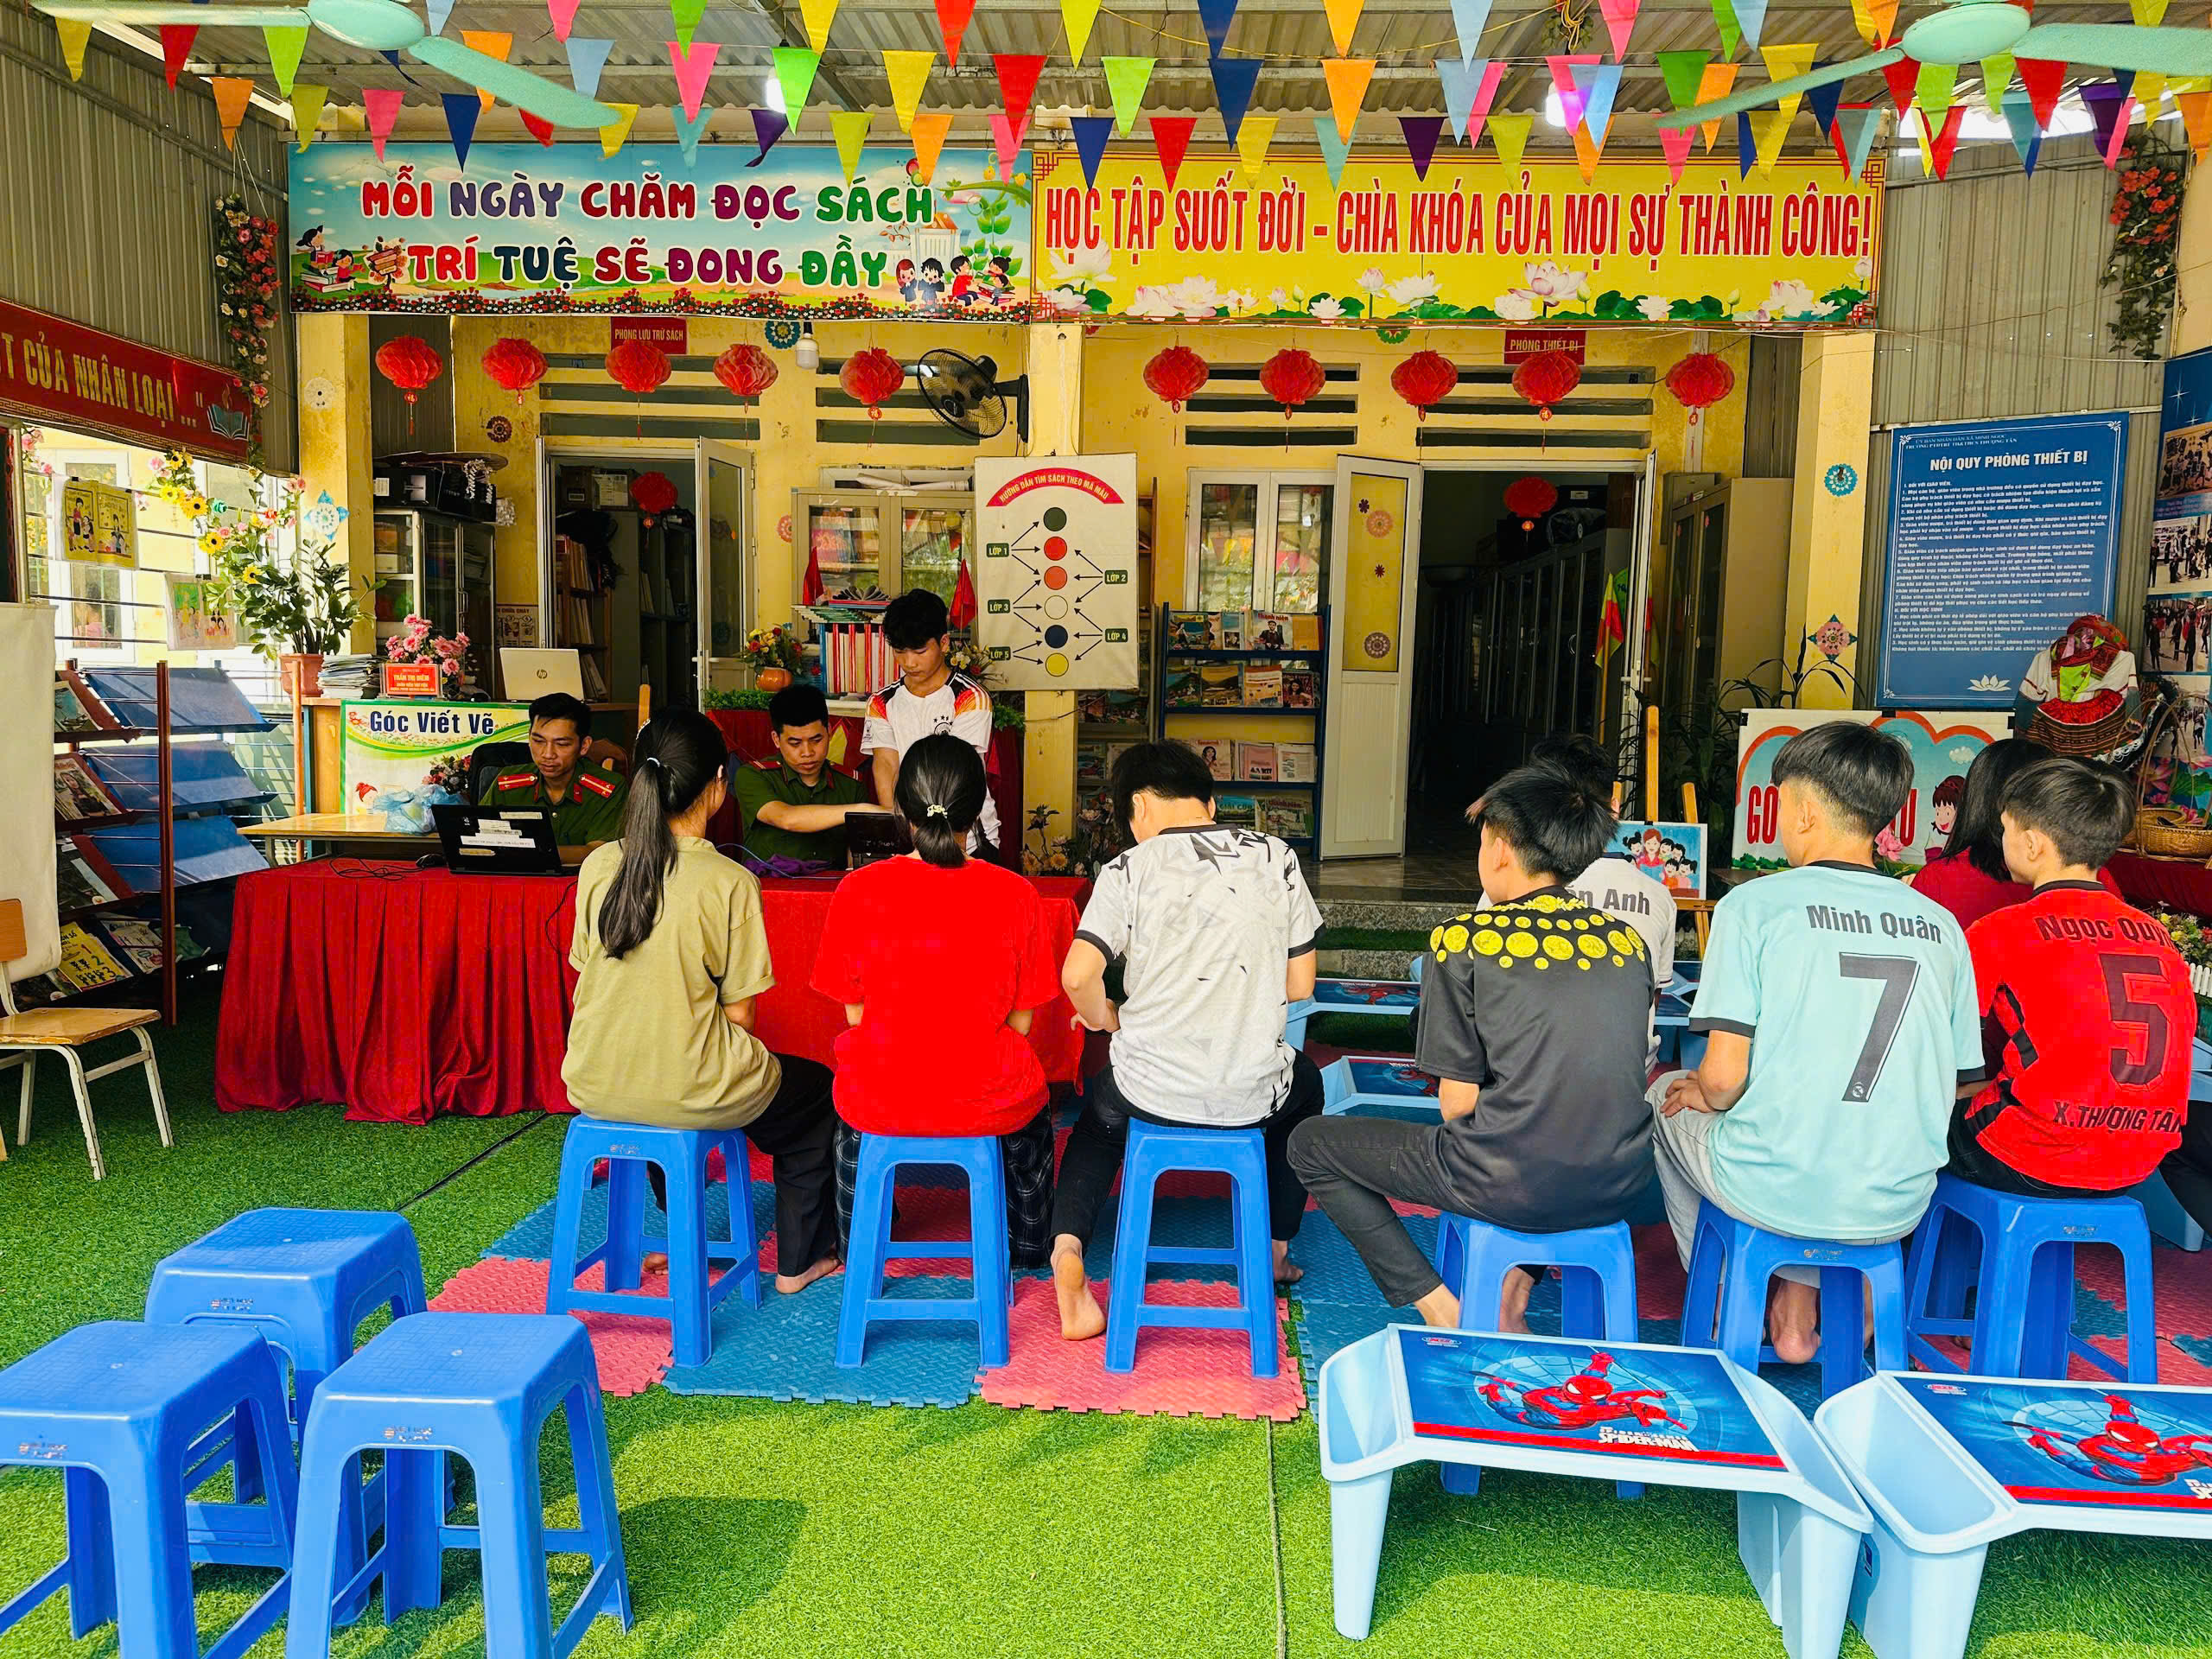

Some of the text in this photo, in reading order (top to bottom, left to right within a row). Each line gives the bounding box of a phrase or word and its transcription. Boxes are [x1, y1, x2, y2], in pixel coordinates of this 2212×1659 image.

[362, 167, 932, 228] MỖI NGÀY CHĂM ĐỌC SÁCH
[1046, 187, 1100, 264] HỌC
[1111, 185, 1163, 264] TẬP
[1174, 170, 1249, 253] SUỐT
[1258, 181, 1304, 253] ĐỜI
[1337, 181, 1399, 255] CHÌA
[1410, 179, 1485, 255] KHÓA
[1496, 173, 1553, 255] CỦA
[1564, 194, 1618, 269] MỌI
[1630, 185, 1669, 270] SỰ
[1681, 181, 1771, 256] THÀNH
[1782, 177, 1871, 257] CÔNG!
[406, 232, 887, 289] TRÍ TUỆ SẼ ĐONG ĐẦY
[615, 327, 683, 340] PHÒNG LƯU TRỮ SÁCH
[1510, 337, 1578, 353] PHÒNG THIẾT BỊ
[23, 332, 68, 394] CỦA
[73, 353, 129, 410] NHÂN
[132, 372, 174, 428] LOẠI
[1929, 448, 2088, 473] NỘI QUY PHÒNG THIẾT BỊ
[1048, 473, 1065, 483] SÁCH
[1067, 474, 1082, 486] THEO
[988, 546, 1001, 556] LỚP
[1107, 573, 1120, 582] LỚP
[989, 602, 1009, 612] LỚP 3
[1107, 632, 1127, 640] LỚP 4
[990, 650, 1003, 659] LỚP
[370, 709, 493, 735] Góc Viết Vẽ
[1603, 889, 1649, 916] Anh
[1807, 905, 1942, 944] Minh Quân
[2034, 915, 2113, 944] Ngọc
[1840, 951, 1921, 1103] 7
[2099, 953, 2170, 1087] 5
